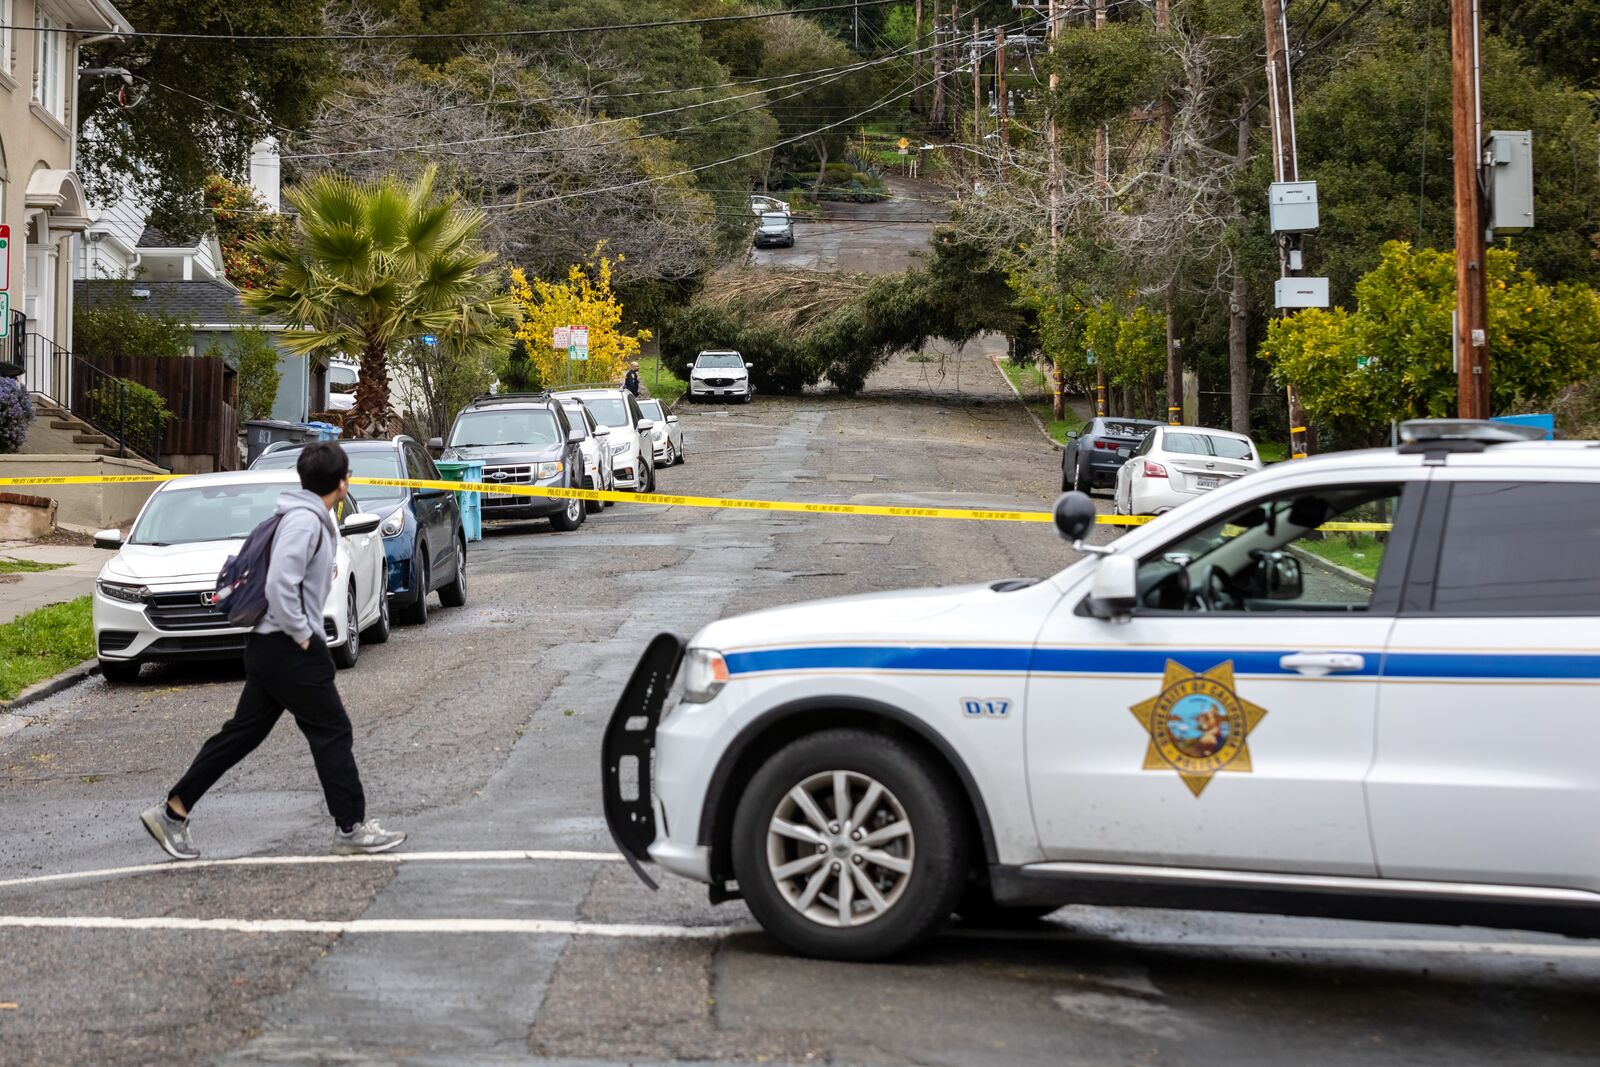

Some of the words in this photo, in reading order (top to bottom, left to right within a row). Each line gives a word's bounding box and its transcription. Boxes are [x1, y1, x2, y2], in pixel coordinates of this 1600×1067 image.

[1157, 685, 1186, 746] UNIVERSITY
[1193, 683, 1206, 691] OF
[1210, 686, 1241, 748] CALIFORNIA
[1176, 756, 1221, 770] POLICE
